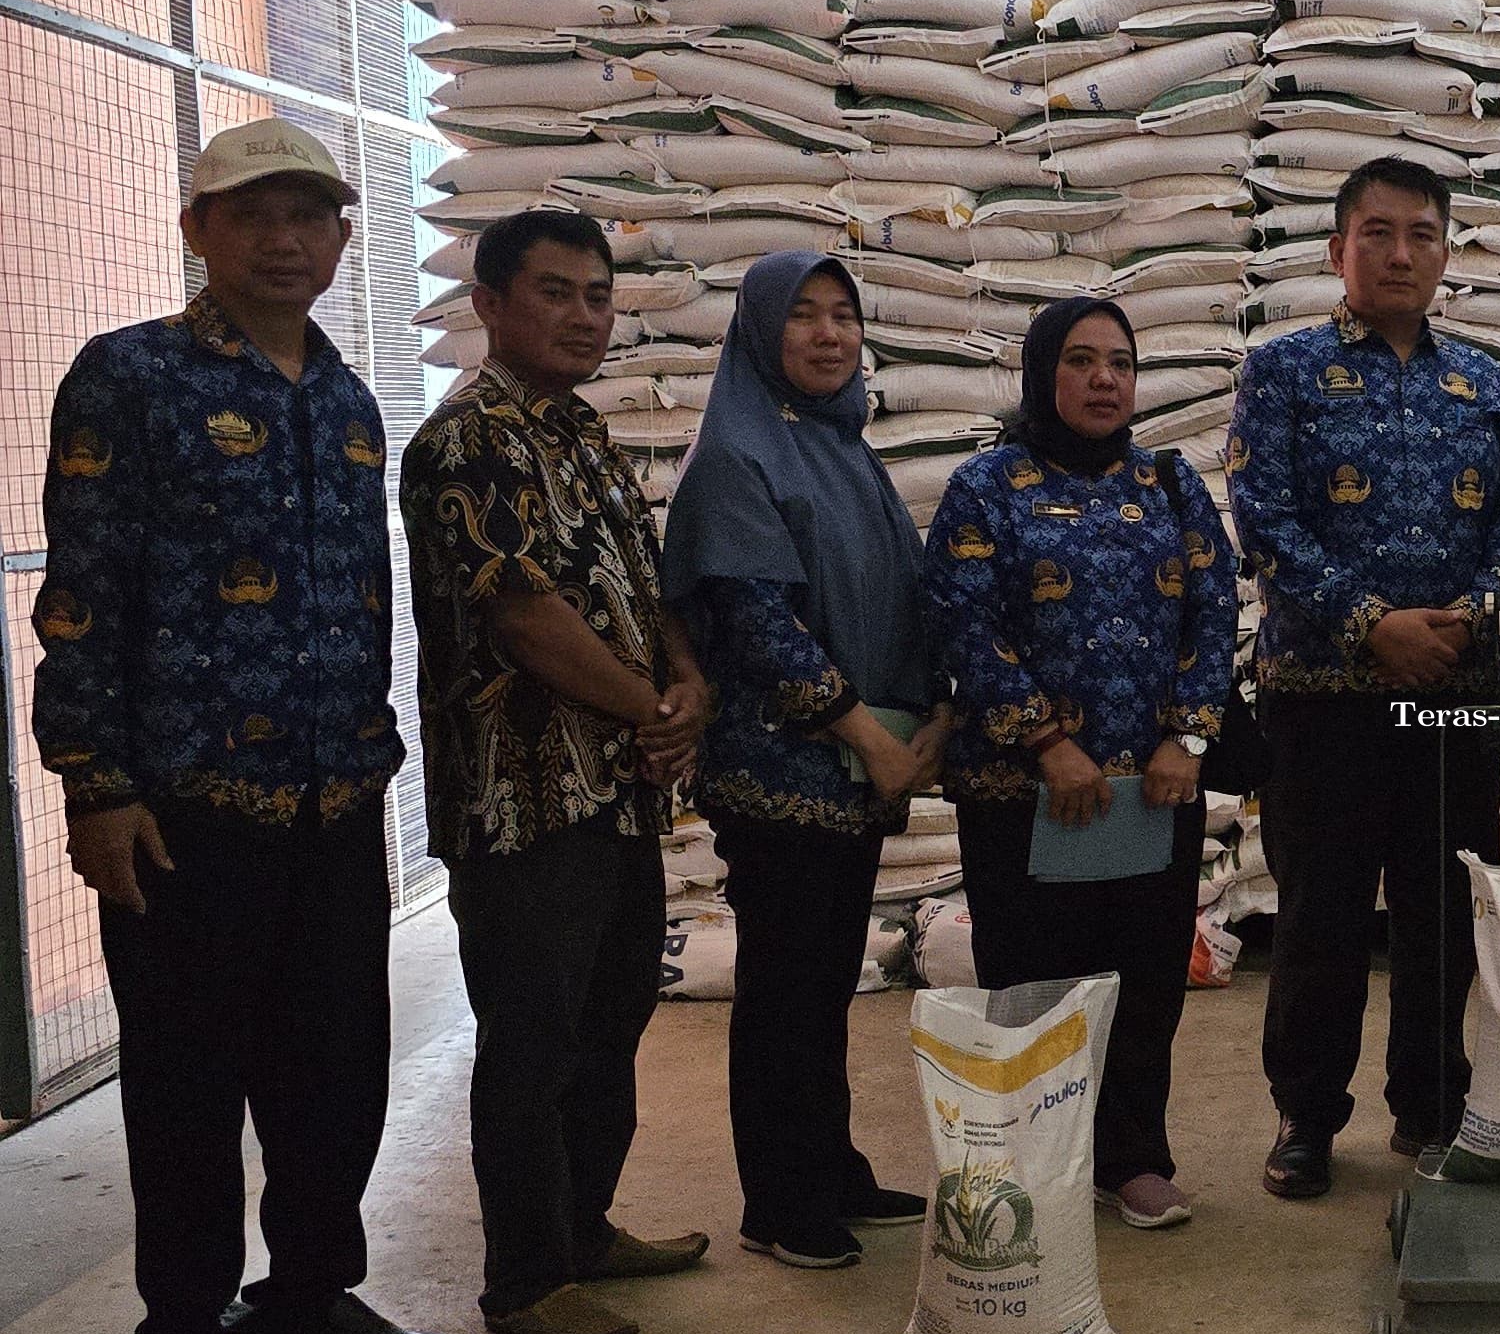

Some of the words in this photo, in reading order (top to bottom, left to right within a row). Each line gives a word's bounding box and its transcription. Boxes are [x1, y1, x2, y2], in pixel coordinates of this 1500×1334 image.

[1044, 1077, 1088, 1110] bulog
[946, 1272, 985, 1292] BERAS
[972, 1298, 997, 1316] 10
[1002, 1299, 1027, 1318] kg
